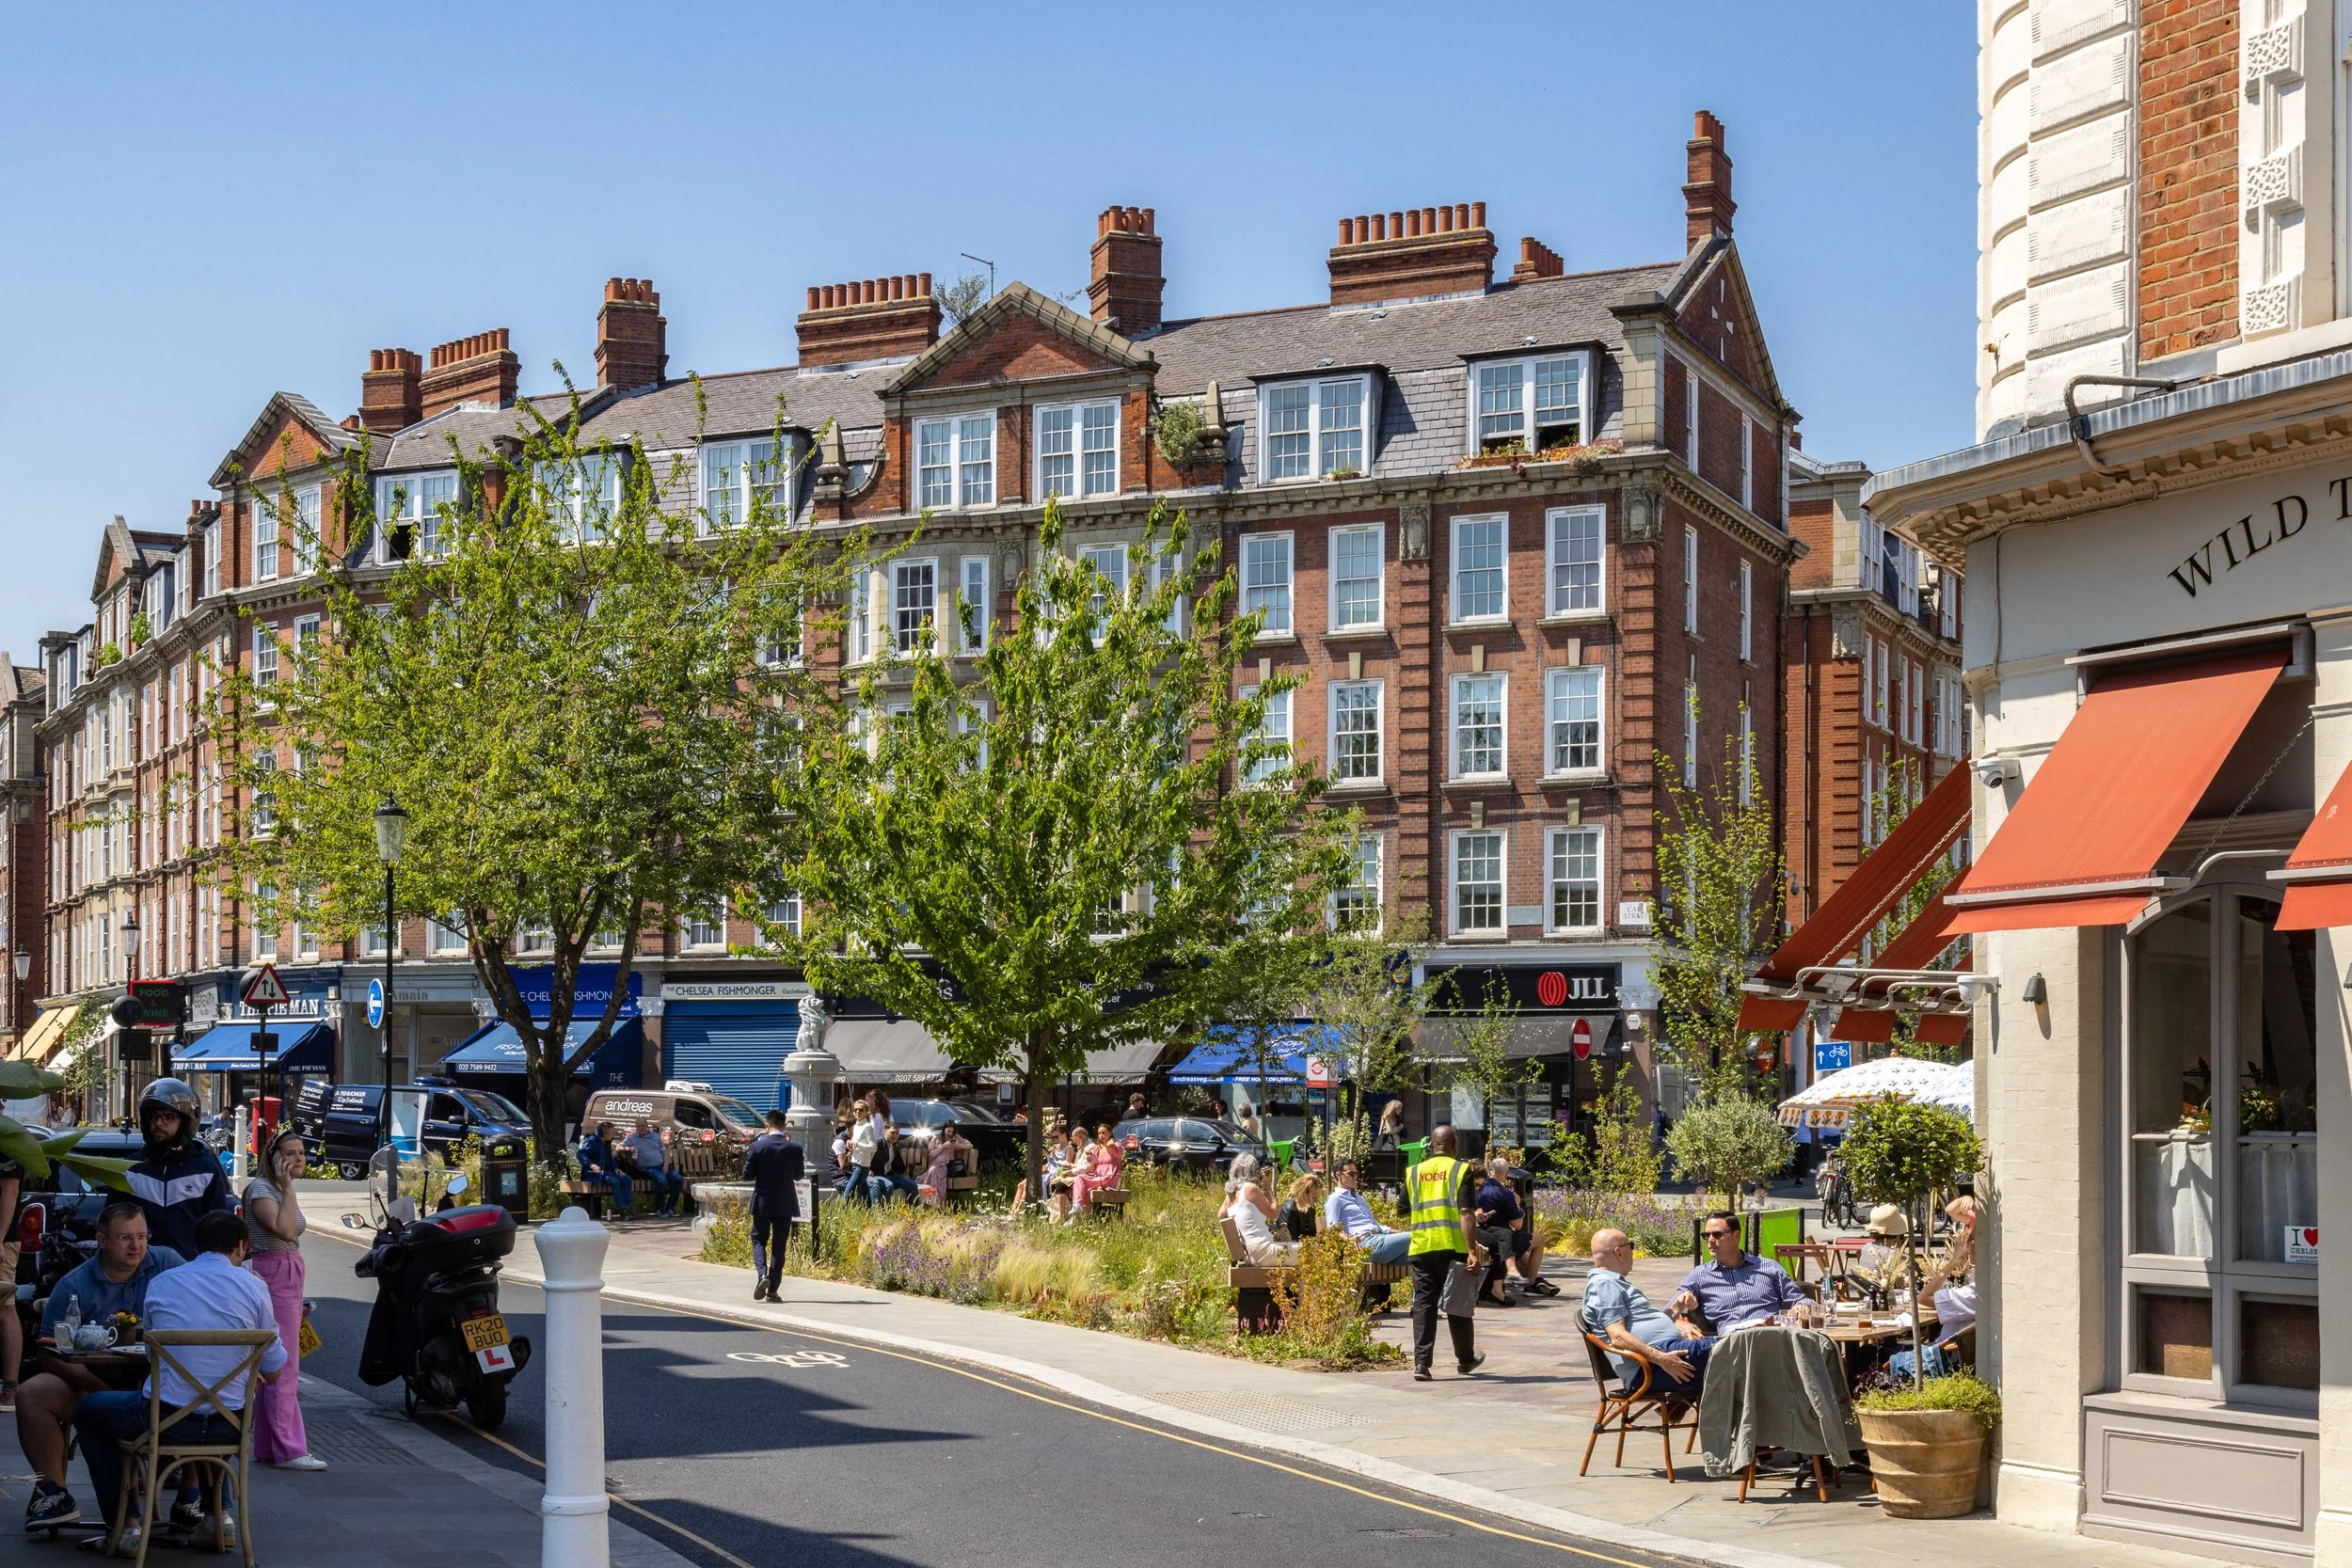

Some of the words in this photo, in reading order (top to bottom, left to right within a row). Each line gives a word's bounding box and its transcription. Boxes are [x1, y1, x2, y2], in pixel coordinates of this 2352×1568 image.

[2167, 494, 2308, 599] WILD
[139, 989, 168, 997] FOOD
[675, 986, 714, 996] CHELSEA
[718, 986, 776, 995] FISHMONGER
[1568, 977, 1610, 1000] JLL
[289, 999, 320, 1015] MAN
[609, 1072, 624, 1083] THE
[1096, 1075, 1113, 1084] local
[605, 1098, 653, 1113] andreas
[1420, 1171, 1447, 1181] YODEL
[2292, 1228, 2301, 1246] I
[465, 1318, 503, 1337] RK20
[484, 1349, 504, 1367] L
